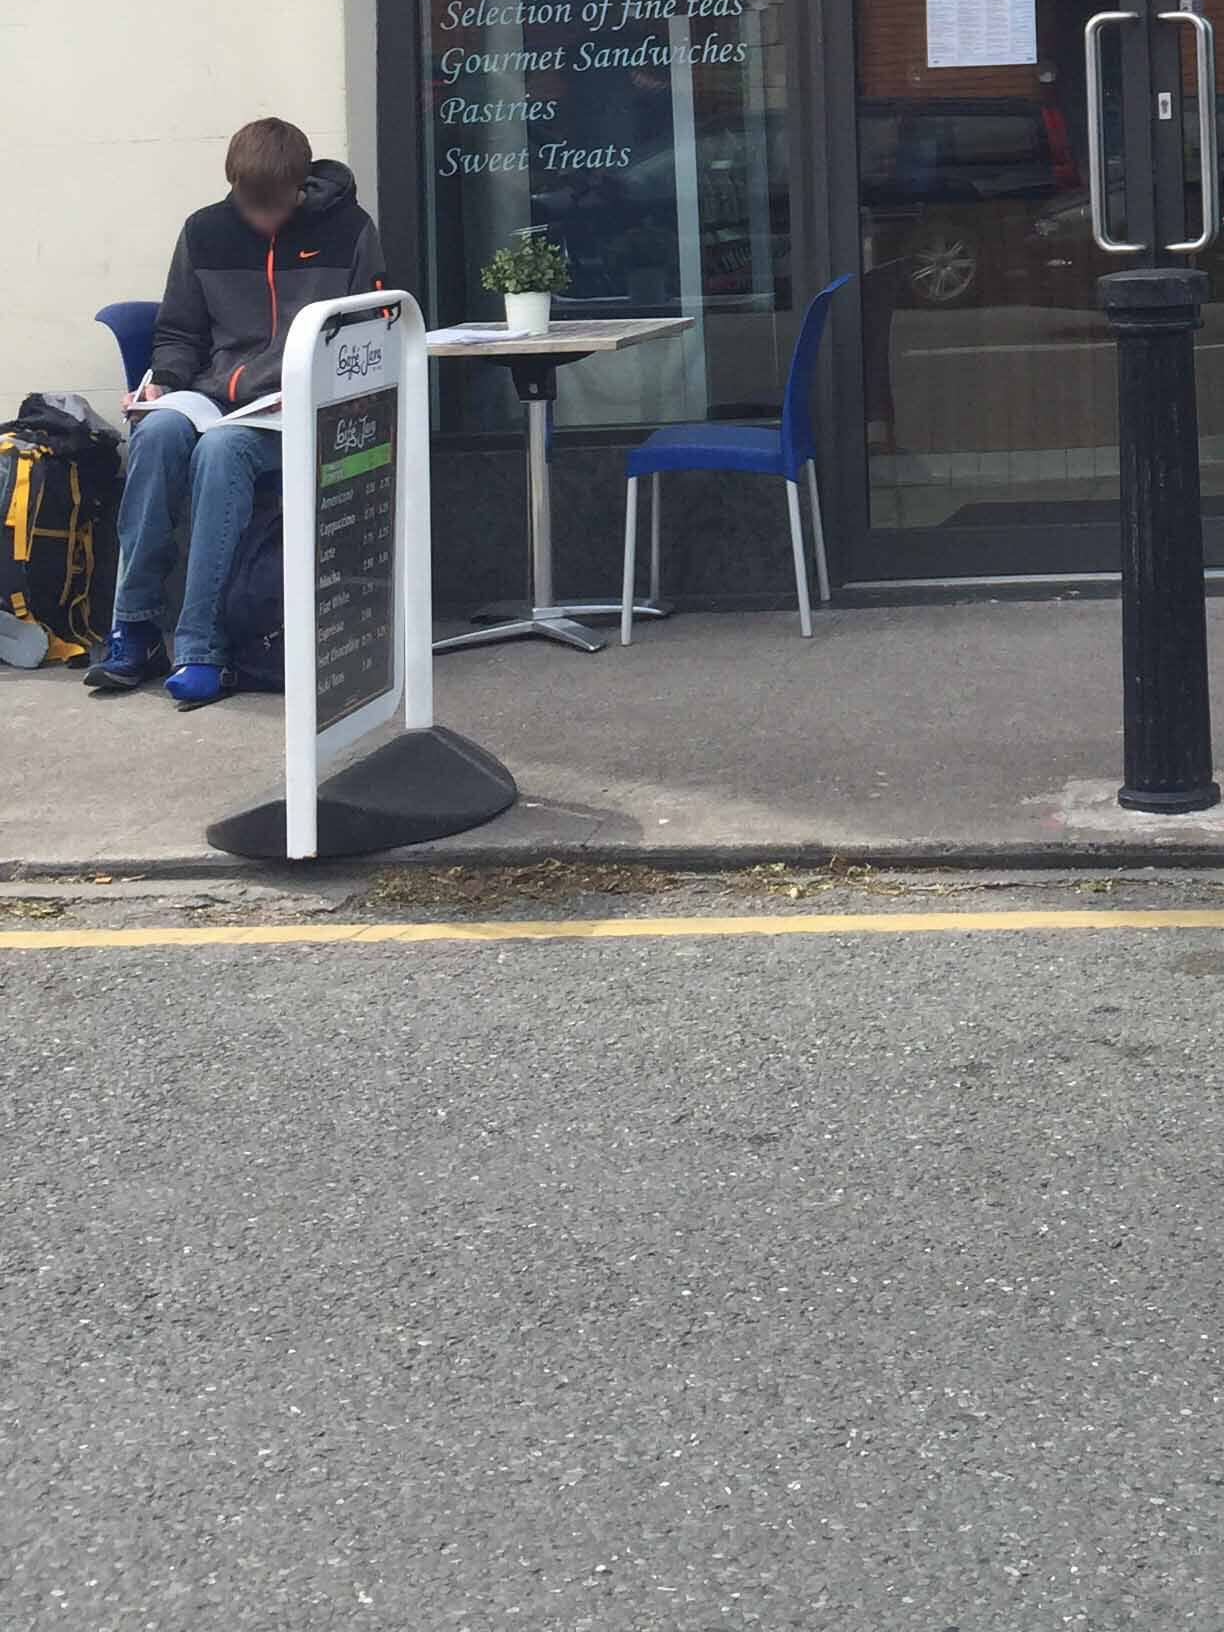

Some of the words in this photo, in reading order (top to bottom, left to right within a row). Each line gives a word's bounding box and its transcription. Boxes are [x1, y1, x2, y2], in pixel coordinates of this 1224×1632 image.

[441, 47, 567, 85] Gourmet
[573, 32, 748, 72] Sandwiches
[440, 94, 558, 125] Pastries
[439, 146, 530, 177] Sweet
[538, 140, 632, 171] Treats
